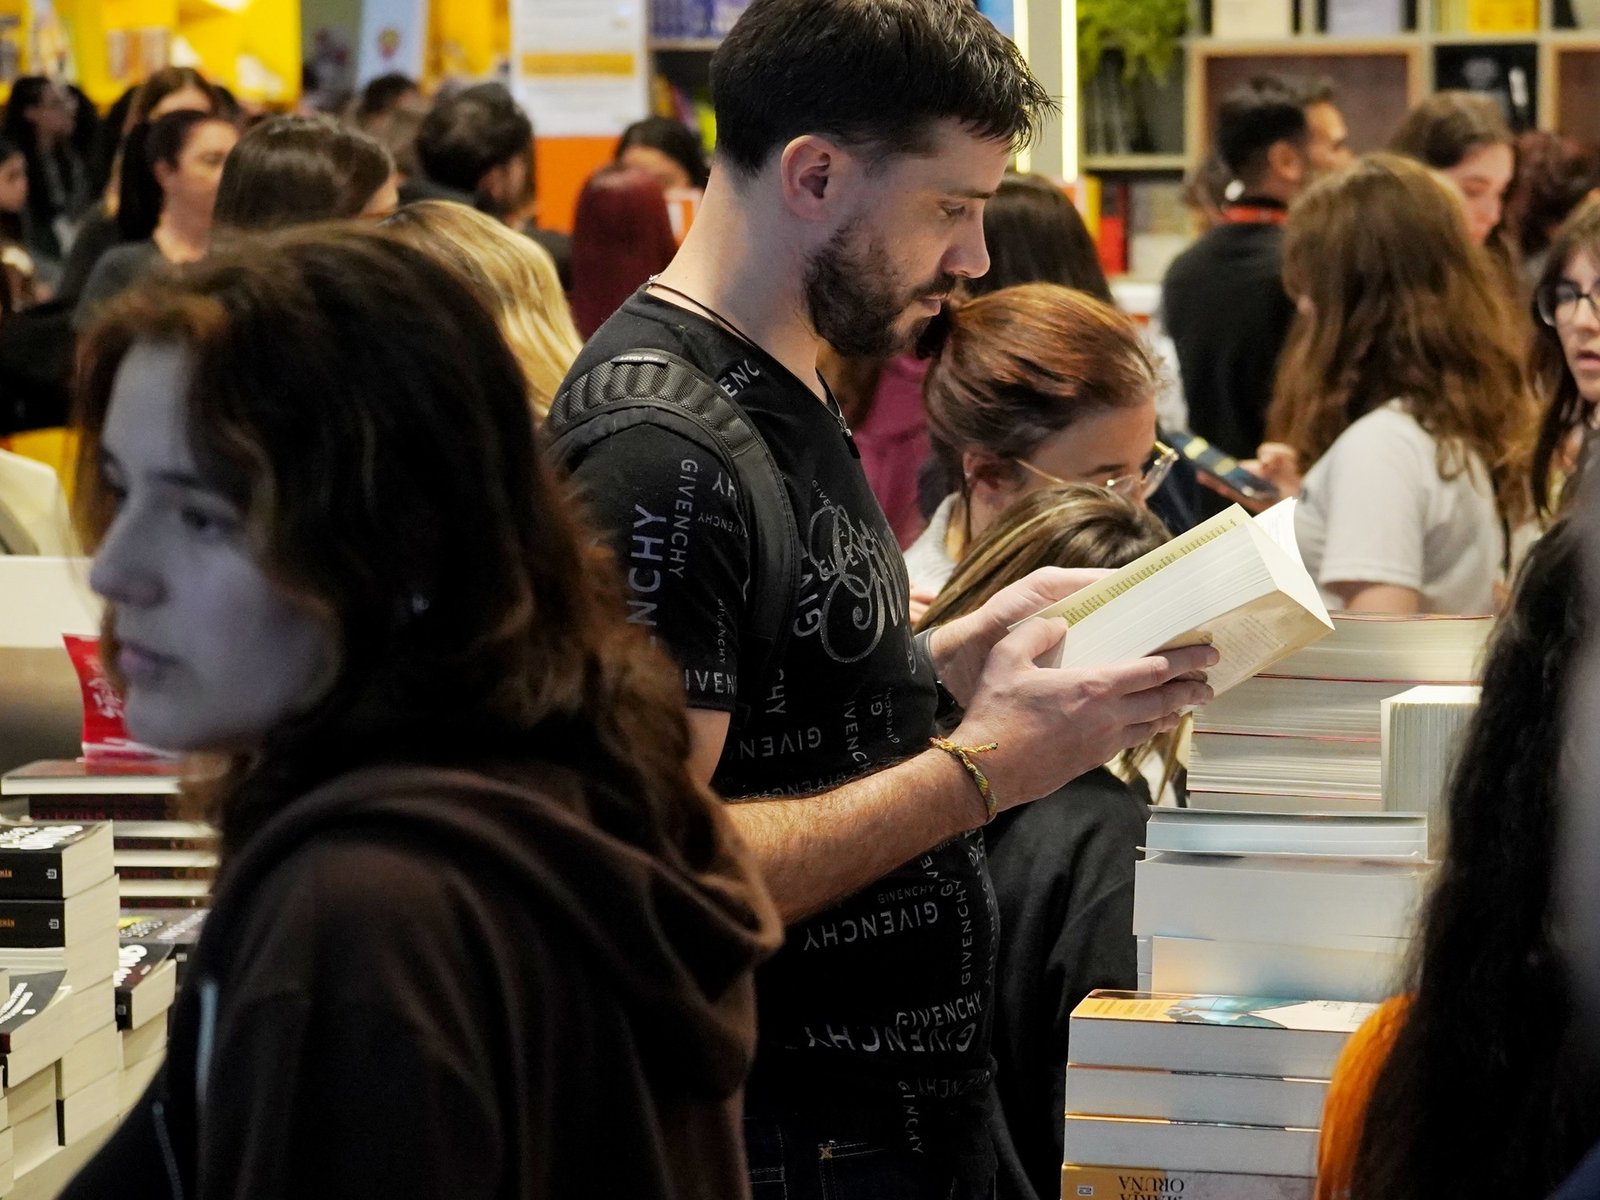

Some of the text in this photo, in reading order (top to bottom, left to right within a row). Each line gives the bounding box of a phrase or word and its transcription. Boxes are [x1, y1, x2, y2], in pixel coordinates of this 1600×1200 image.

[669, 458, 698, 579] GIVENCHY
[625, 504, 667, 646] NCHY
[878, 884, 936, 905] GIVENCHY
[804, 901, 939, 951] GIVENCHY
[955, 879, 978, 986] GIVENCHY
[896, 990, 984, 1026] GIVENCHY
[1118, 1175, 1185, 1195] ORUÑA
